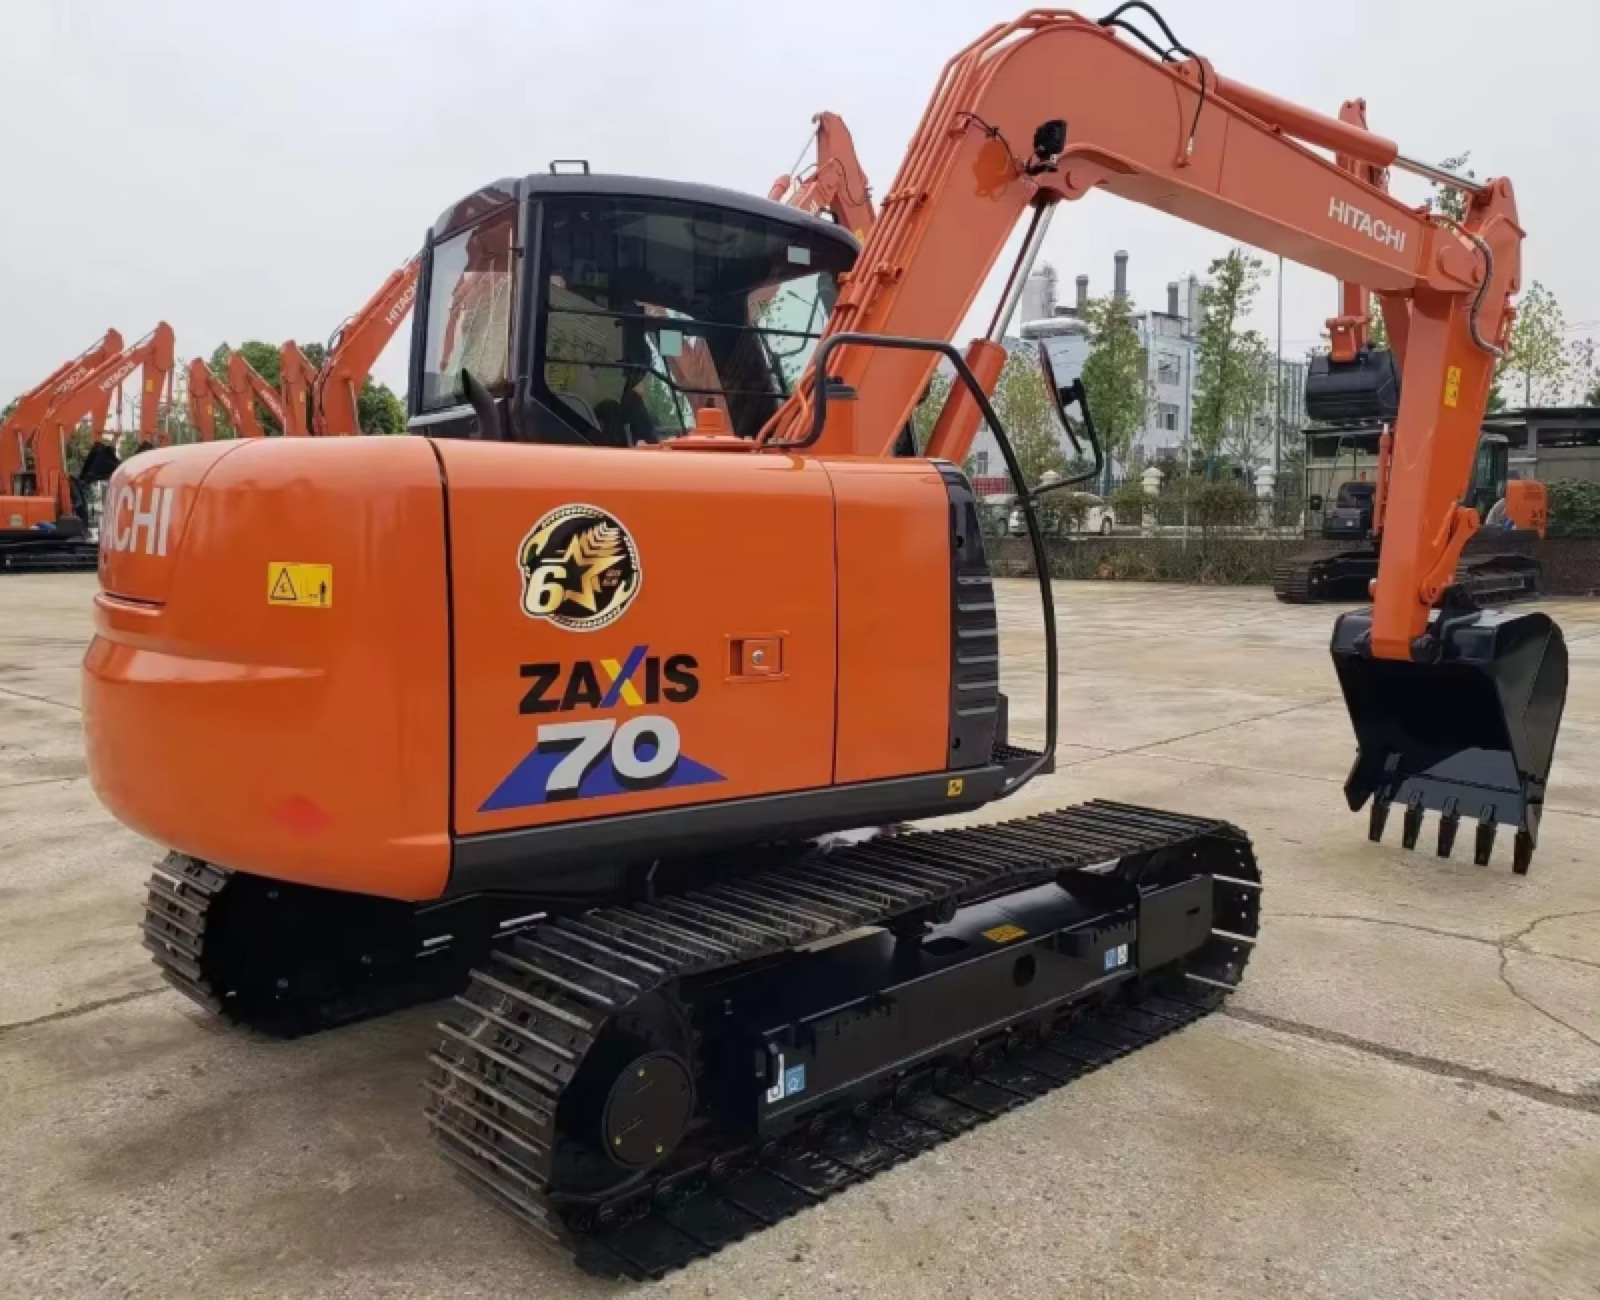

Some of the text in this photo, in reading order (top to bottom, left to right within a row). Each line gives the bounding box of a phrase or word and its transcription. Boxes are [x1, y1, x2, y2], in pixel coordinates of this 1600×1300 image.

[1328, 197, 1406, 252] HITACHI
[519, 645, 699, 714] ZAXIS
[537, 715, 681, 802] 70
